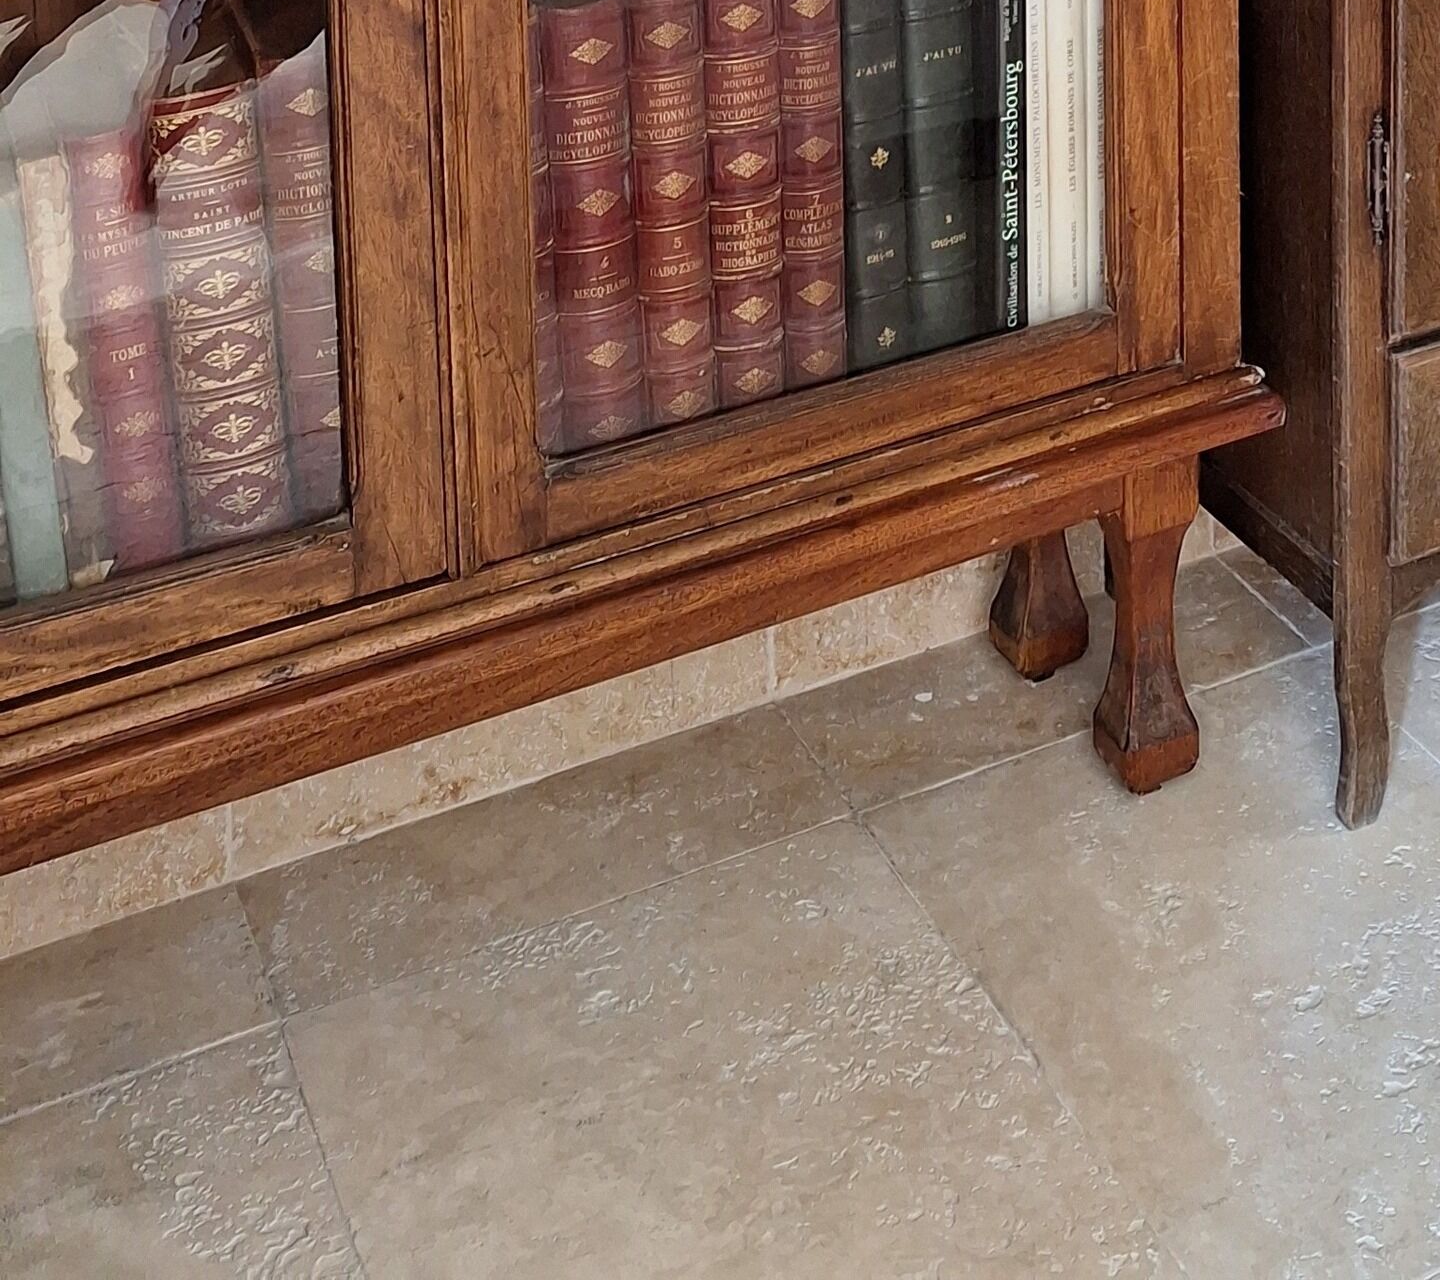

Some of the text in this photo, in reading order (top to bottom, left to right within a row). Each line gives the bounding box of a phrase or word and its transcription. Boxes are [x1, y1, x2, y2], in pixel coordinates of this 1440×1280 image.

[1030, 4, 1039, 17] LA
[1030, 24, 1039, 35] DE
[923, 45, 963, 62] J'AI VU
[1065, 37, 1074, 68] CORSE
[722, 73, 766, 90] NOUVEAU
[1066, 70, 1074, 84] DE
[648, 92, 693, 109] NOUVEAU
[572, 109, 617, 128] NOUVEAU
[1066, 87, 1075, 133] ROMANES
[1032, 127, 1042, 188] MONUMENTS
[1067, 135, 1076, 172] ÉGLISES
[170, 177, 249, 202] ARTHUR LOTH
[1068, 175, 1076, 193] LES
[811, 194, 821, 206] 7
[1001, 60, 1024, 328] Civilisation de Saint-Pétersbourg
[193, 204, 231, 221] SAINT
[160, 224, 213, 241] VINCENT
[214, 218, 233, 233] DE
[800, 219, 833, 235] ATLAS
[673, 236, 683, 250] 5
[110, 342, 147, 363] TOME
[128, 367, 135, 381] 1
